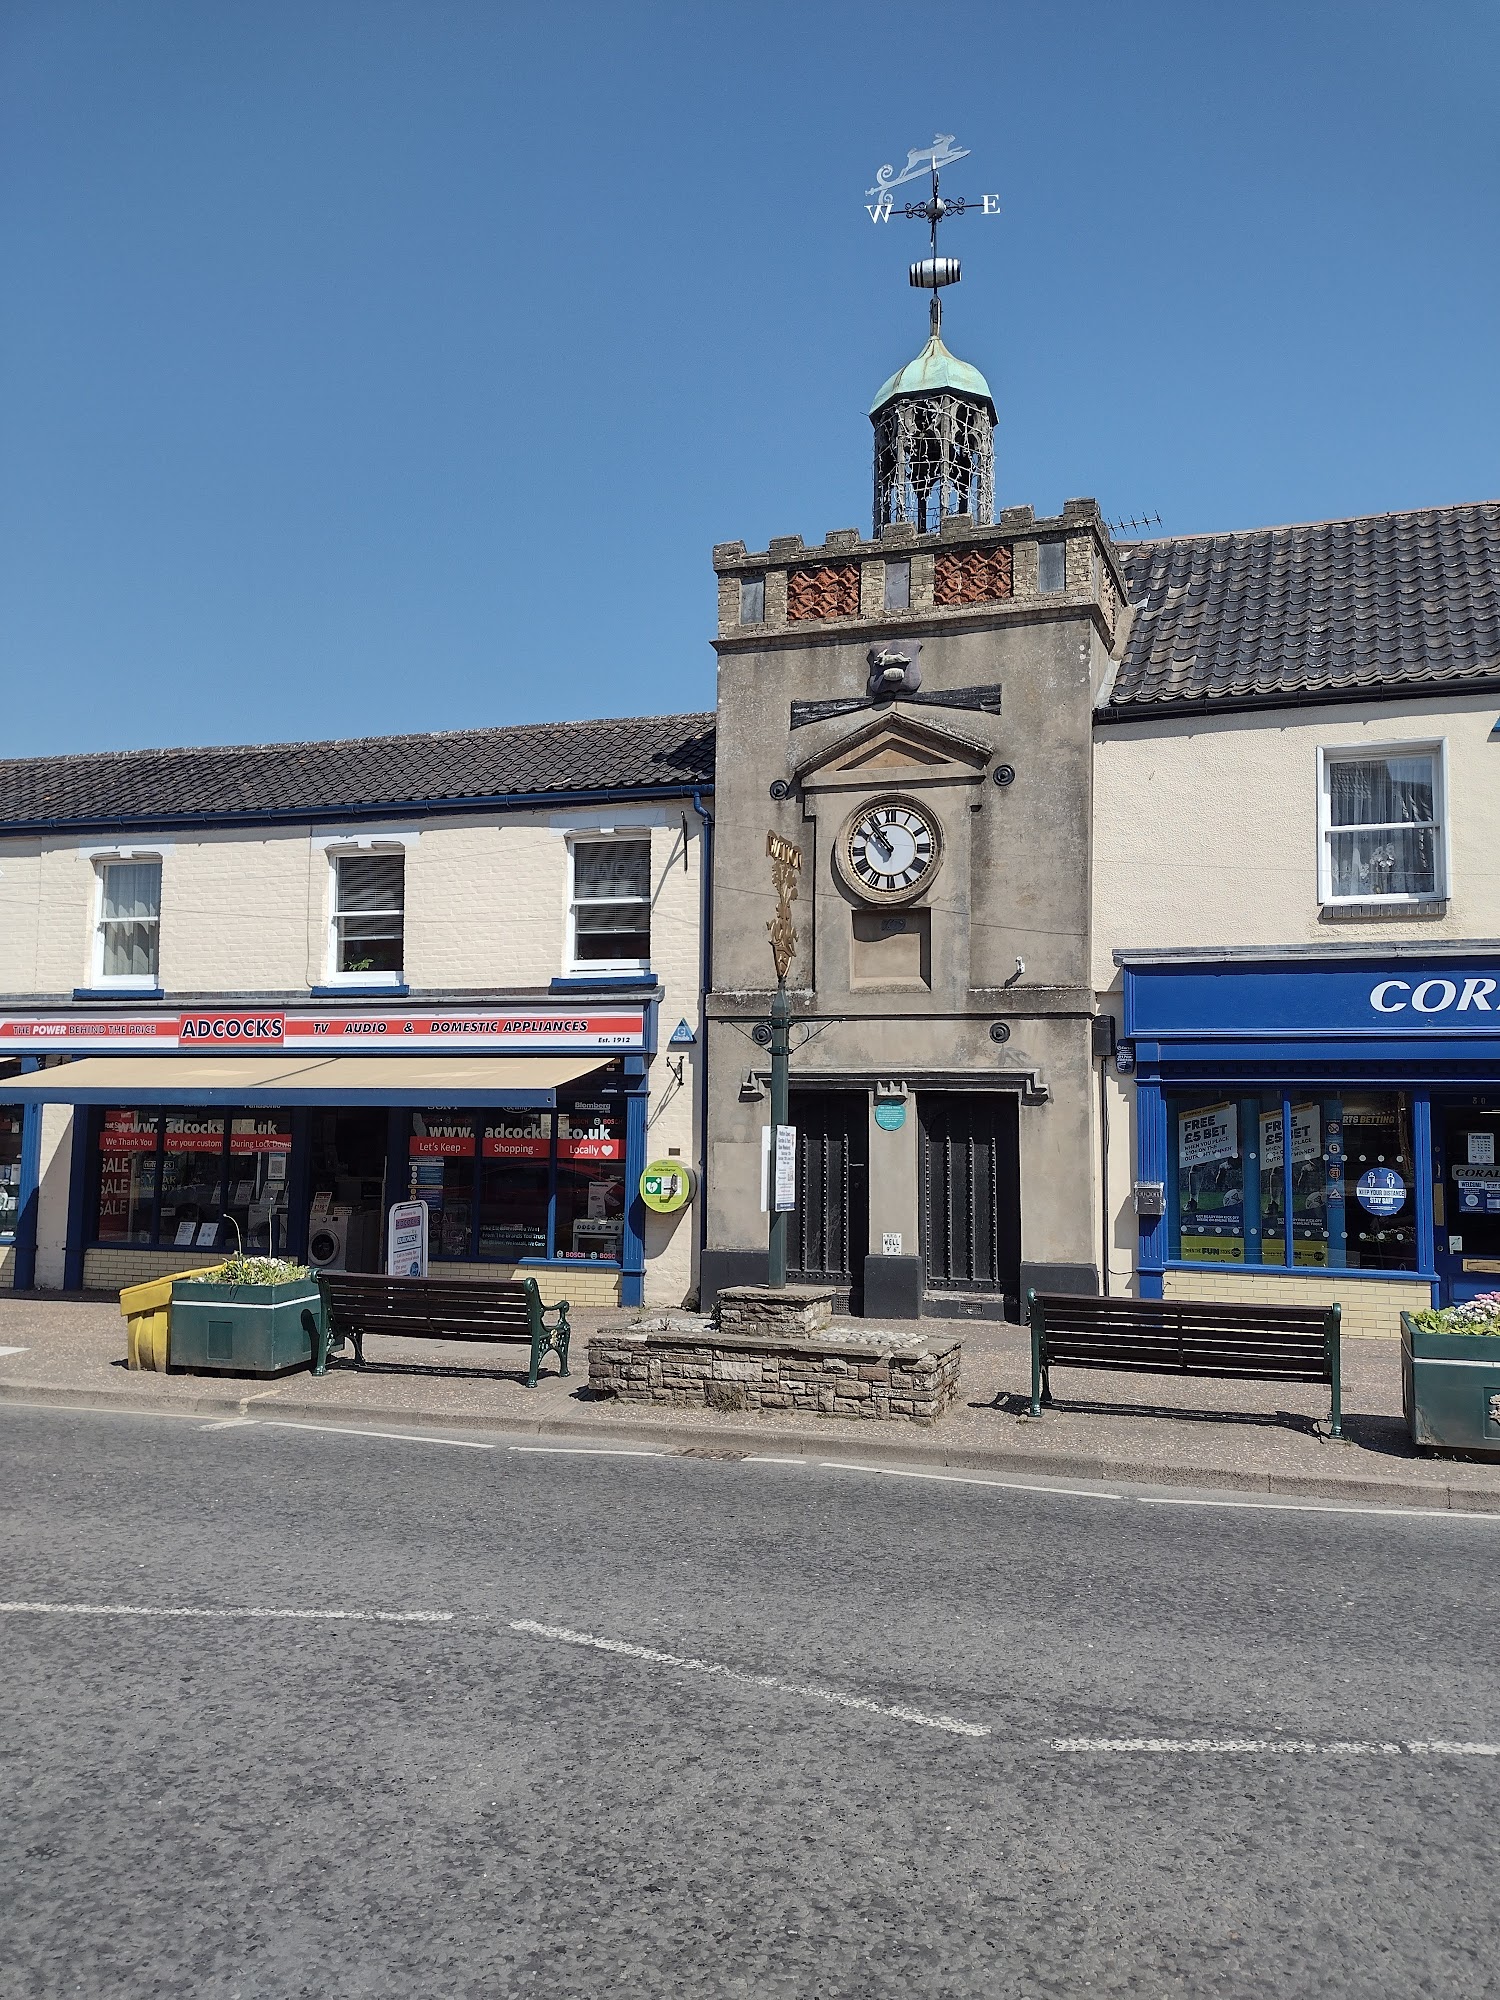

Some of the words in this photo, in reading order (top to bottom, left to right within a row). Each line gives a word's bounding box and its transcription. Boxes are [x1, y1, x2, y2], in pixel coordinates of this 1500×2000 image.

[981, 194, 1001, 215] E
[864, 203, 893, 224] W
[1370, 978, 1500, 1012] COR
[13, 1025, 30, 1035] THE
[32, 1025, 66, 1035] POWER
[69, 1025, 105, 1034] BEHIND
[109, 1025, 126, 1034] THE
[129, 1024, 156, 1034] PRICE
[181, 1018, 283, 1039] ADCOCKS
[313, 1022, 330, 1034] TV
[344, 1022, 387, 1034] AUDIO
[403, 1022, 414, 1033] &
[430, 1021, 498, 1033] DOMESTIC
[502, 1020, 589, 1032] APPLIANCES
[575, 1101, 611, 1109] Blomberg
[1185, 1115, 1215, 1132] FREE
[1265, 1116, 1297, 1133] FRE
[1359, 1115, 1395, 1124] BETTING
[166, 1119, 224, 1134] adcocks
[429, 1126, 475, 1138] www.
[484, 1123, 551, 1139] adcocks
[1185, 1131, 1201, 1144] £5
[1204, 1124, 1227, 1139] BET
[1265, 1132, 1283, 1145] £5
[140, 1138, 153, 1146] You
[167, 1139, 178, 1147] For
[179, 1140, 196, 1148] your
[231, 1139, 254, 1149] During
[255, 1140, 270, 1148] Lock
[420, 1142, 439, 1151] Let's
[440, 1143, 460, 1153] Keep
[494, 1144, 533, 1155] Shopping
[570, 1145, 599, 1156] Locally
[1456, 1168, 1500, 1178] CORAL
[1383, 1189, 1405, 1197] DISTANCE
